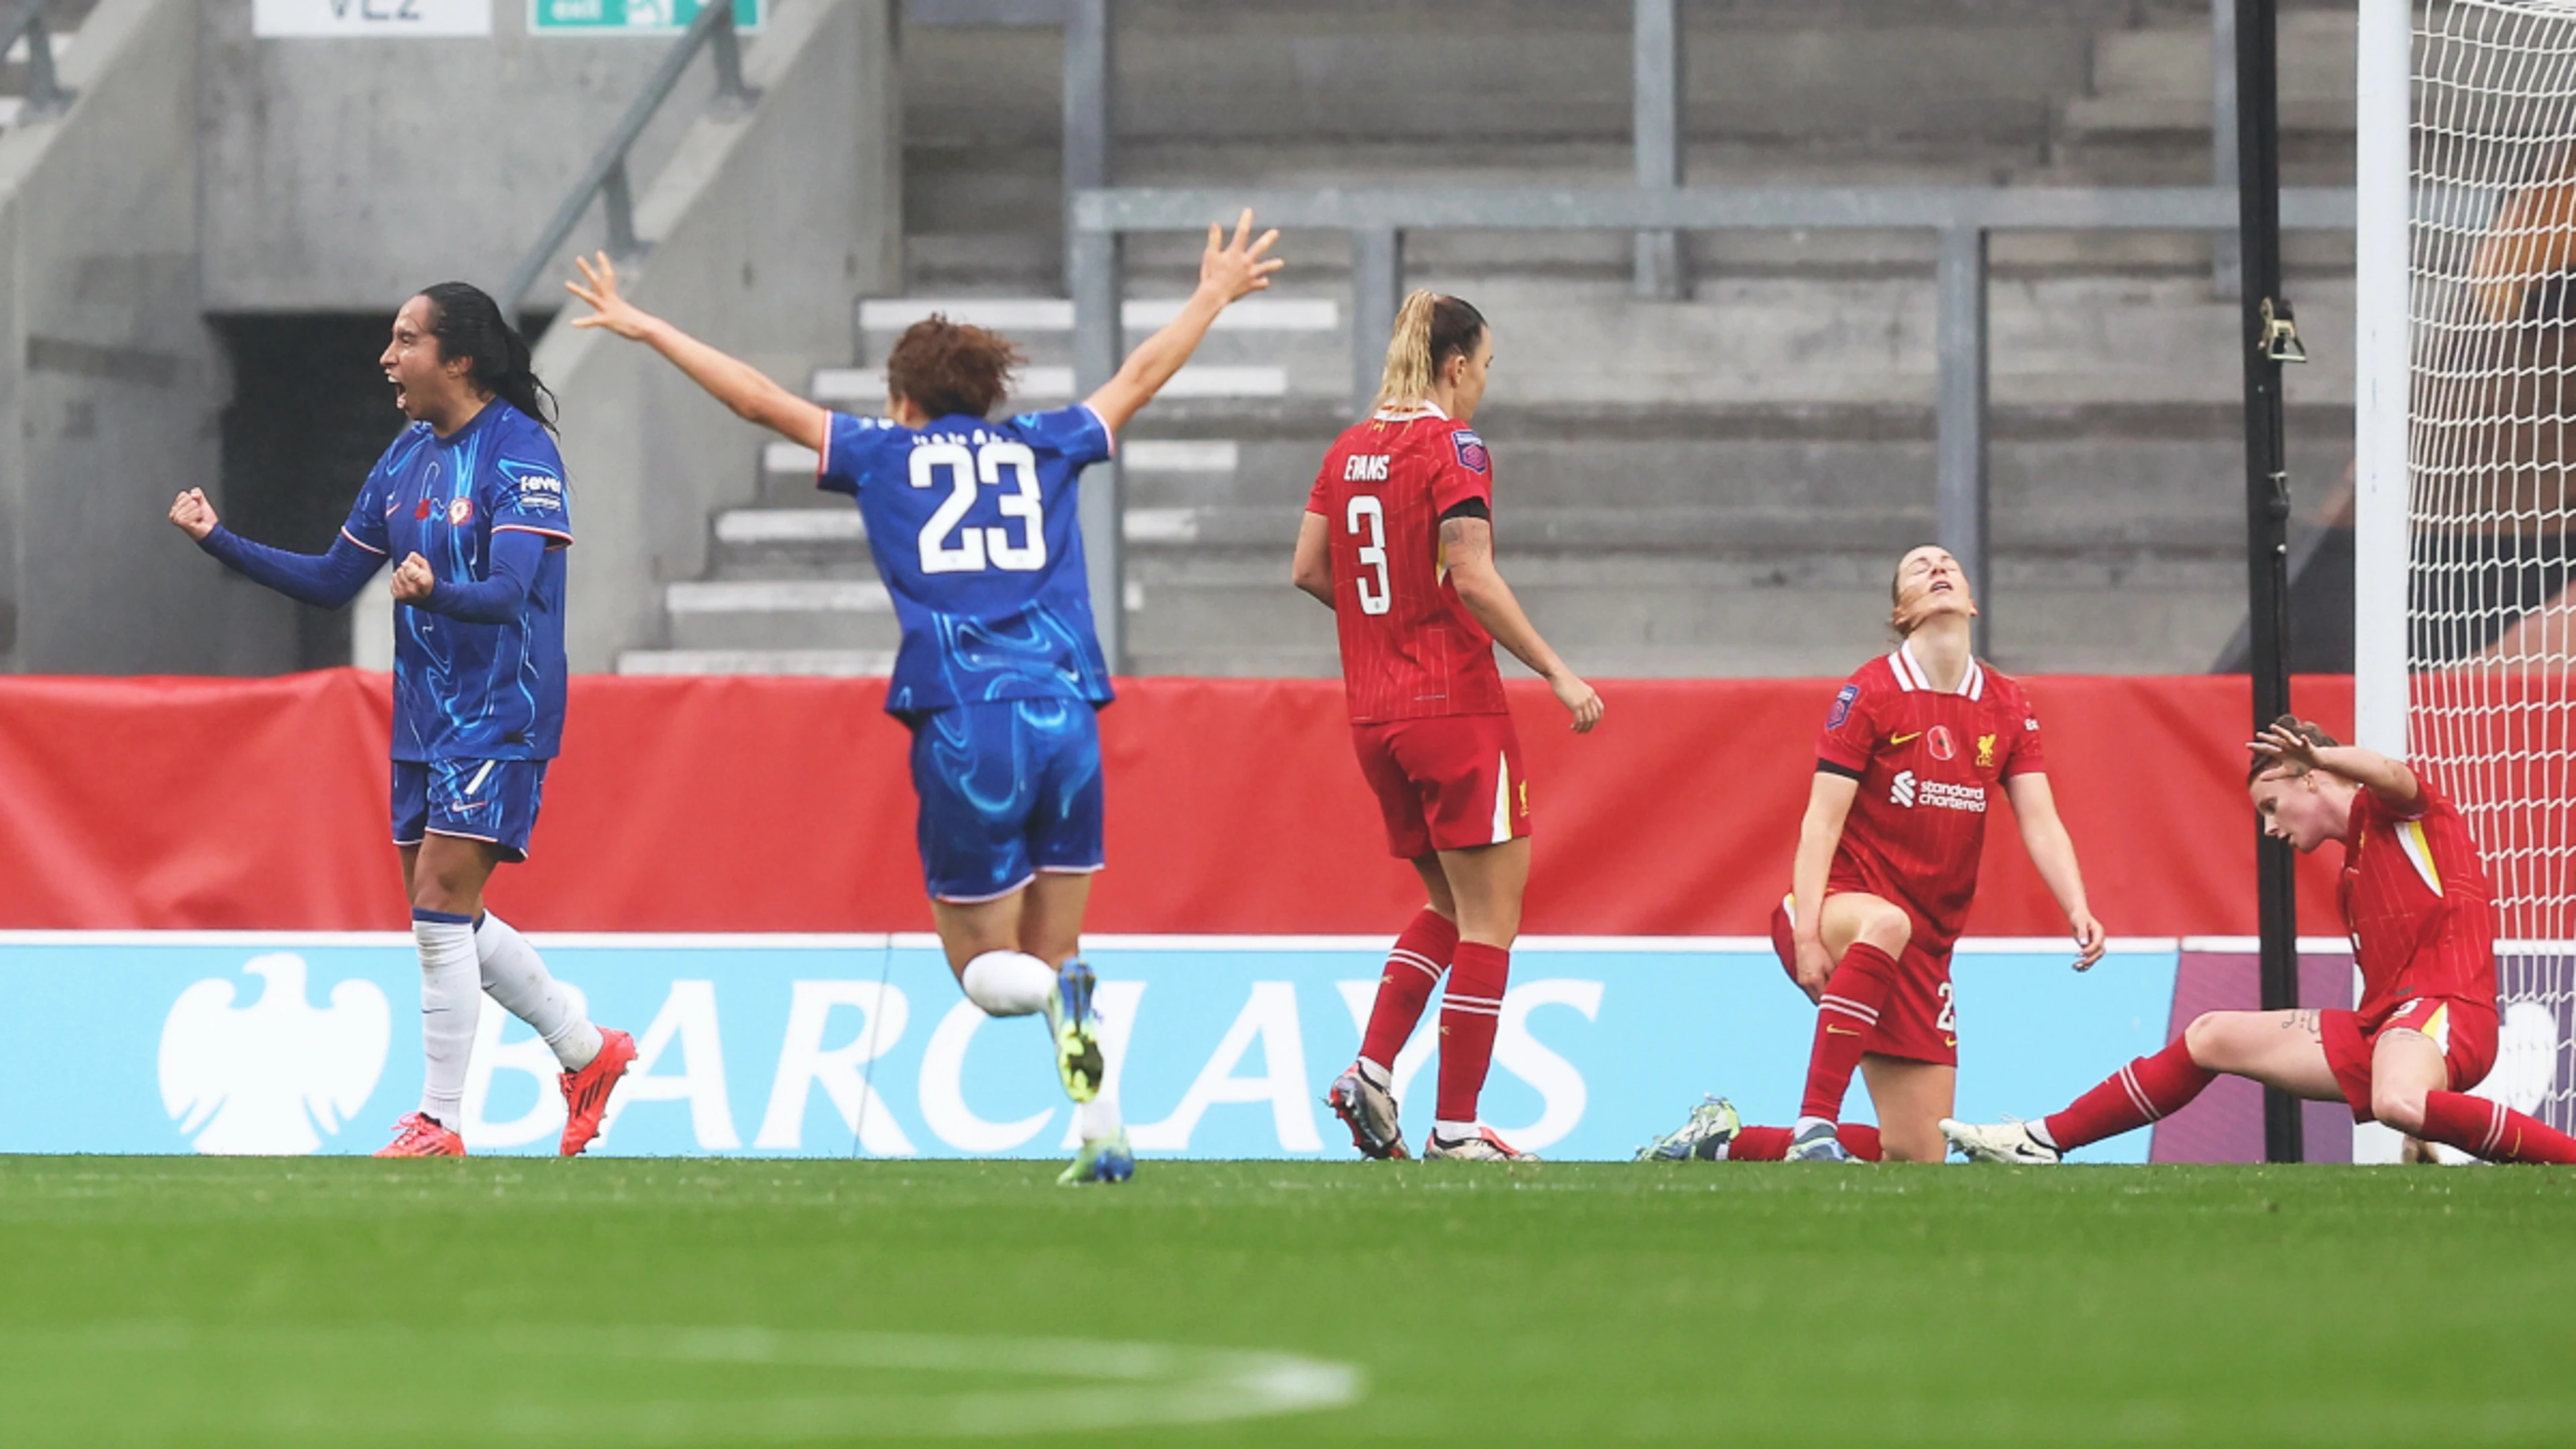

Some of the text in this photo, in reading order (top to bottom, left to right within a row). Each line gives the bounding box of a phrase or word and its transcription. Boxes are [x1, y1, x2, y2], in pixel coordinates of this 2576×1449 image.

[1343, 454, 1391, 481] EVANS
[909, 443, 1046, 573] 23
[1347, 494, 1391, 615] 3
[1920, 779, 1984, 800] standard
[1919, 794, 1986, 813] chartered
